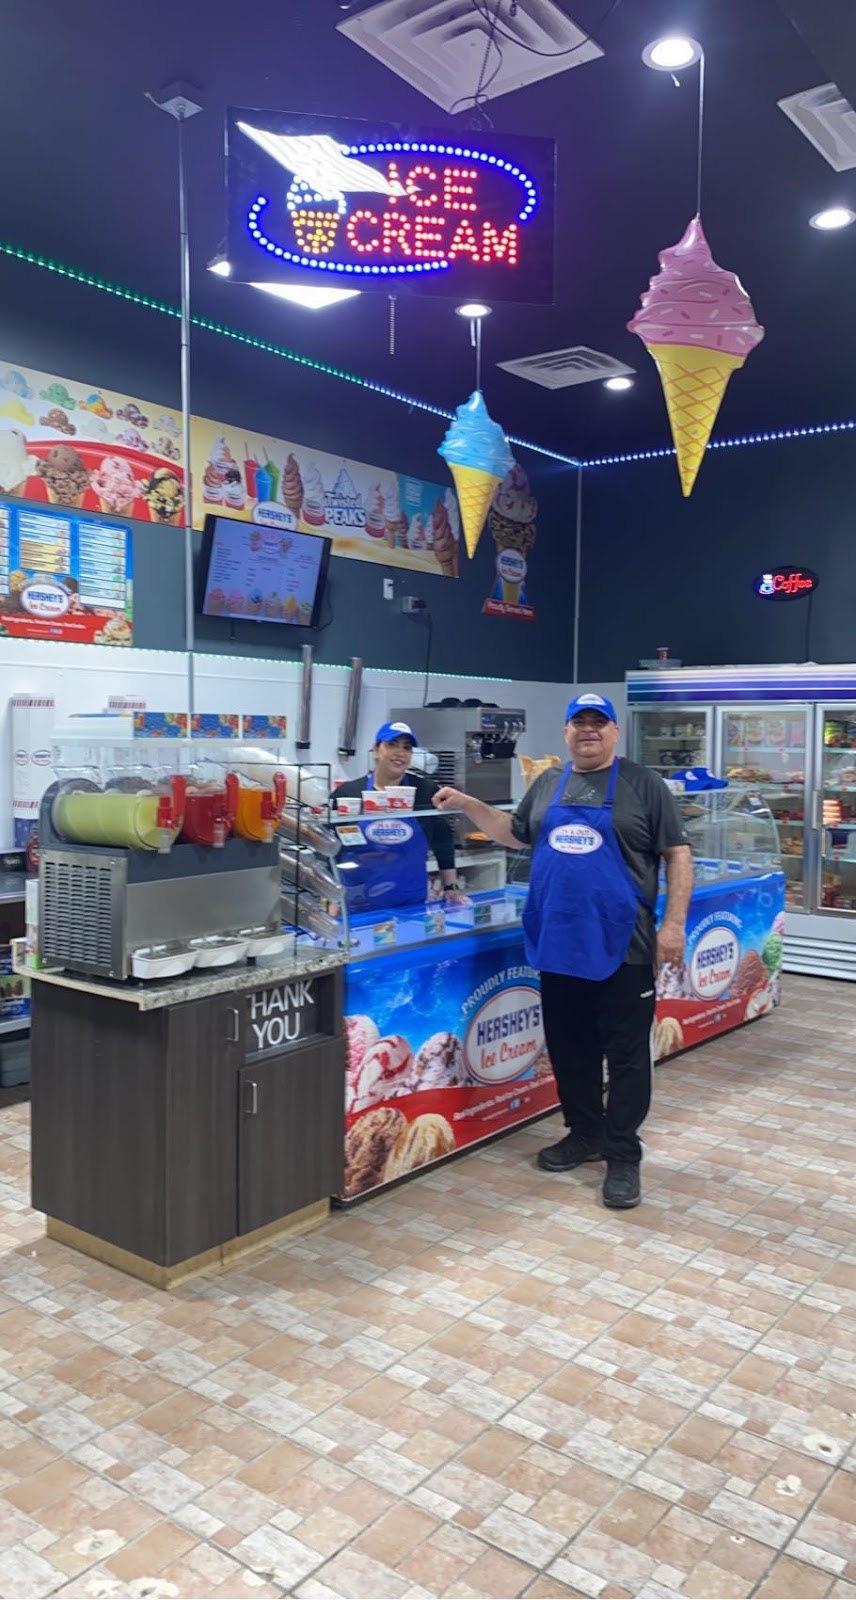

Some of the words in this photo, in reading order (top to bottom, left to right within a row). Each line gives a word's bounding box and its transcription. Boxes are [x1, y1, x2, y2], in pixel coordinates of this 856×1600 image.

[389, 162, 477, 211] ICE
[346, 210, 517, 265] CREAM
[257, 507, 292, 523] HERSHEY'S
[324, 508, 367, 528] PEAKS
[27, 591, 64, 603] HERSHEY'S
[773, 573, 813, 593] Coffee
[555, 834, 595, 846] HERSHEY'S
[696, 941, 735, 970] HERSHEY'S
[246, 979, 314, 1019] HANK
[461, 970, 505, 1015] PROUDLY
[252, 1012, 300, 1048] YOU
[476, 1003, 541, 1046] HERSHEY'S
[481, 1047, 496, 1069] Ice
[500, 1040, 537, 1062] Cream
